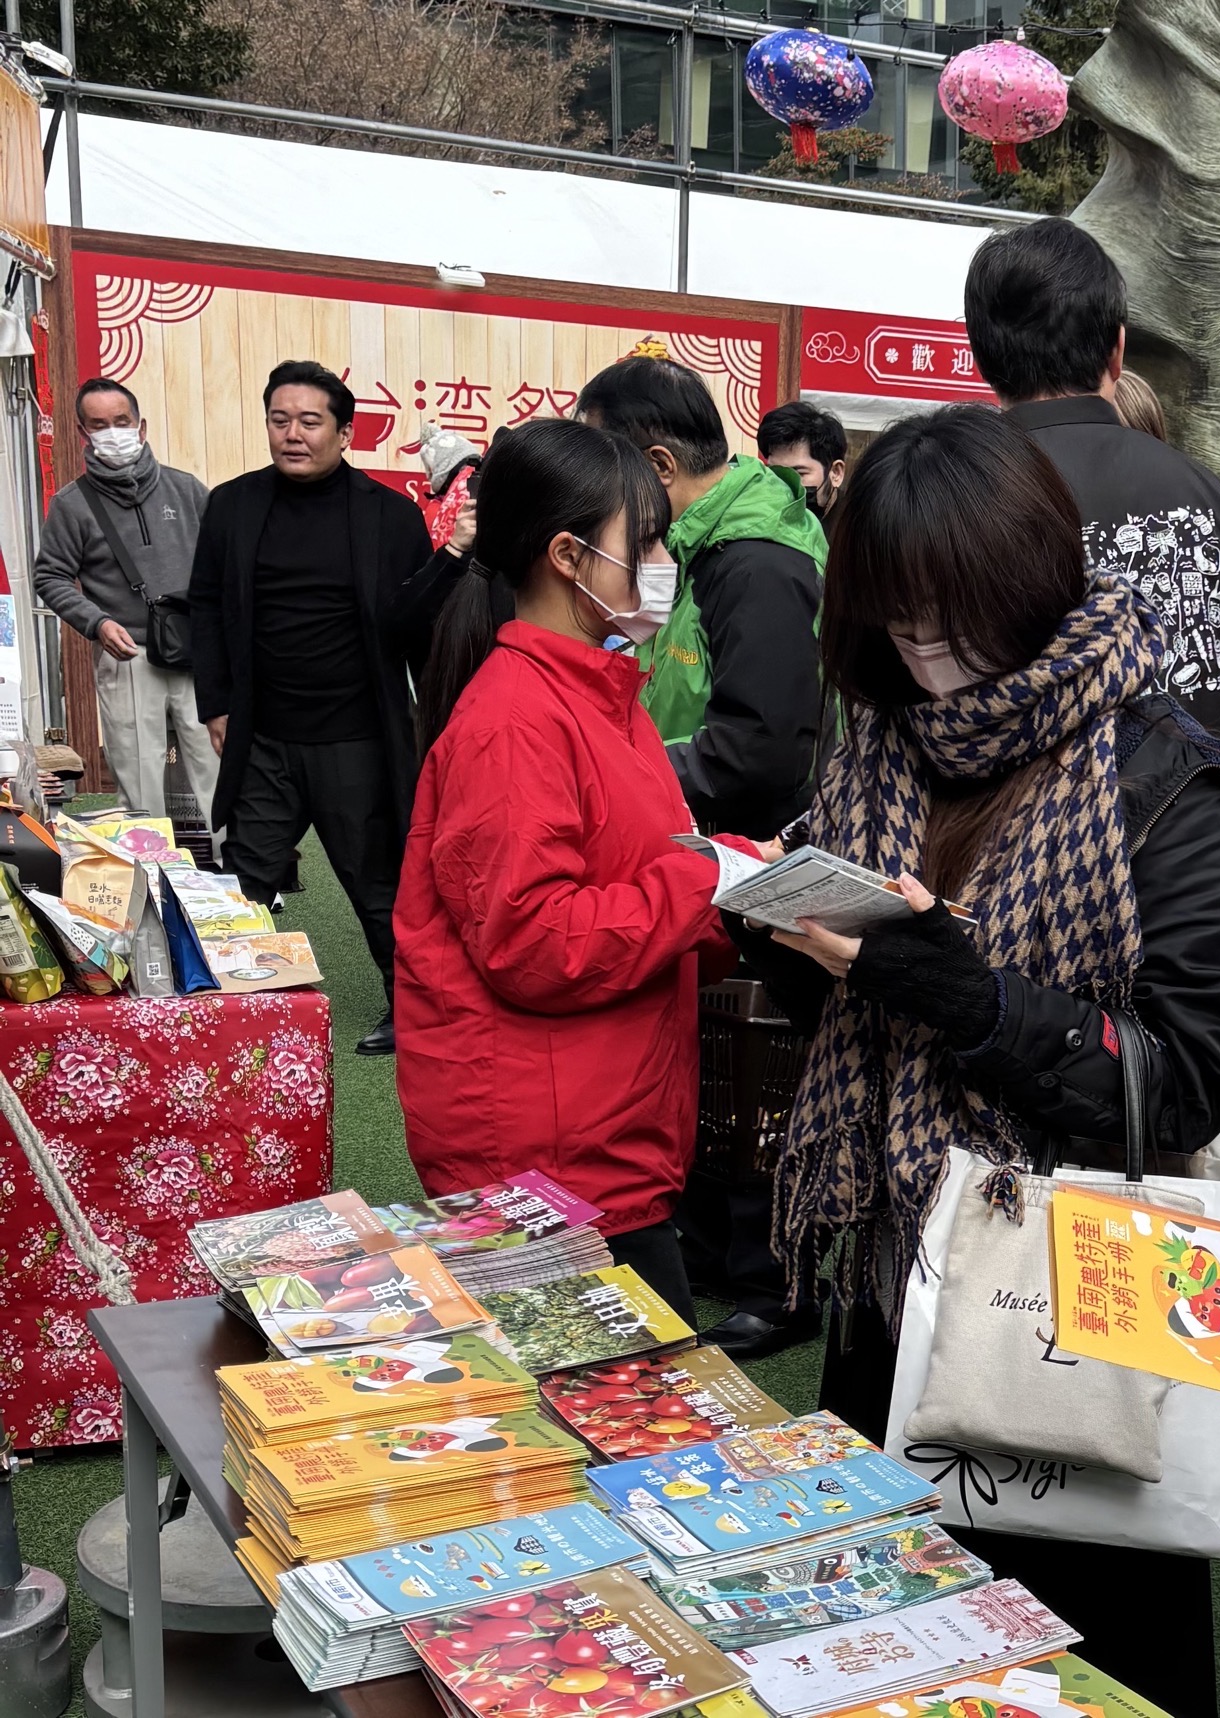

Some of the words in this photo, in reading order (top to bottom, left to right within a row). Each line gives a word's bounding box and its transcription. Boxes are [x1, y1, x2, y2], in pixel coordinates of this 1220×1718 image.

[367, 1273, 434, 1320] 芒果
[989, 1288, 1048, 1313] Musée
[1072, 1219, 1110, 1337] 臺南農特產
[1107, 1241, 1139, 1333] 外銷手冊
[830, 1463, 893, 1507] 台南市の観光地
